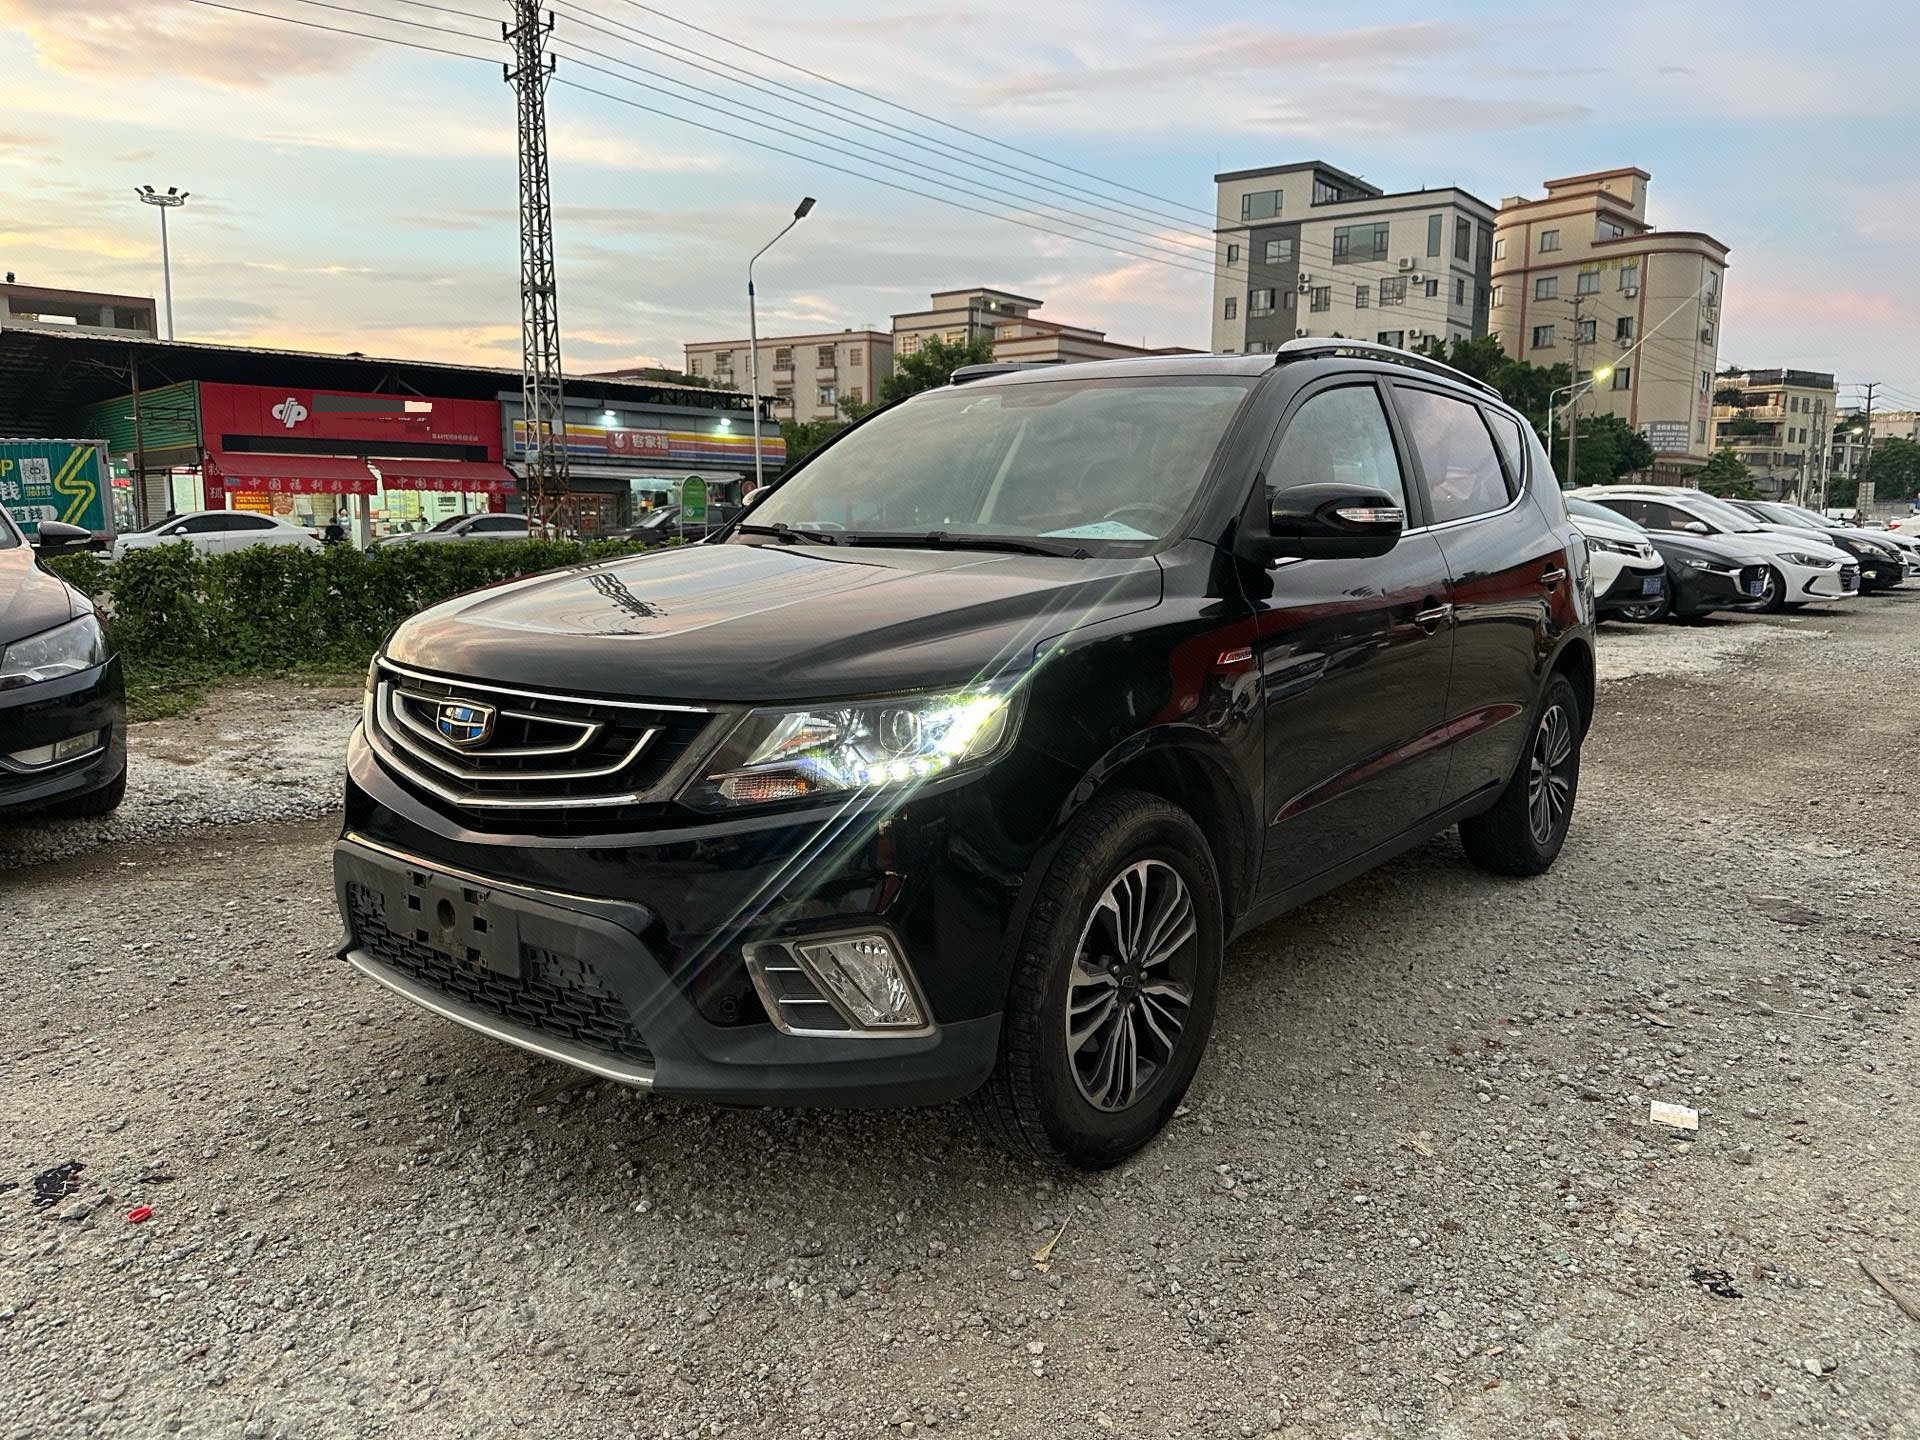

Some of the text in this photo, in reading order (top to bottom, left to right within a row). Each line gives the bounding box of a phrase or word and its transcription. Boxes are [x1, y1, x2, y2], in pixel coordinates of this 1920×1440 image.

[248, 477, 362, 492] 中国福利彩票
